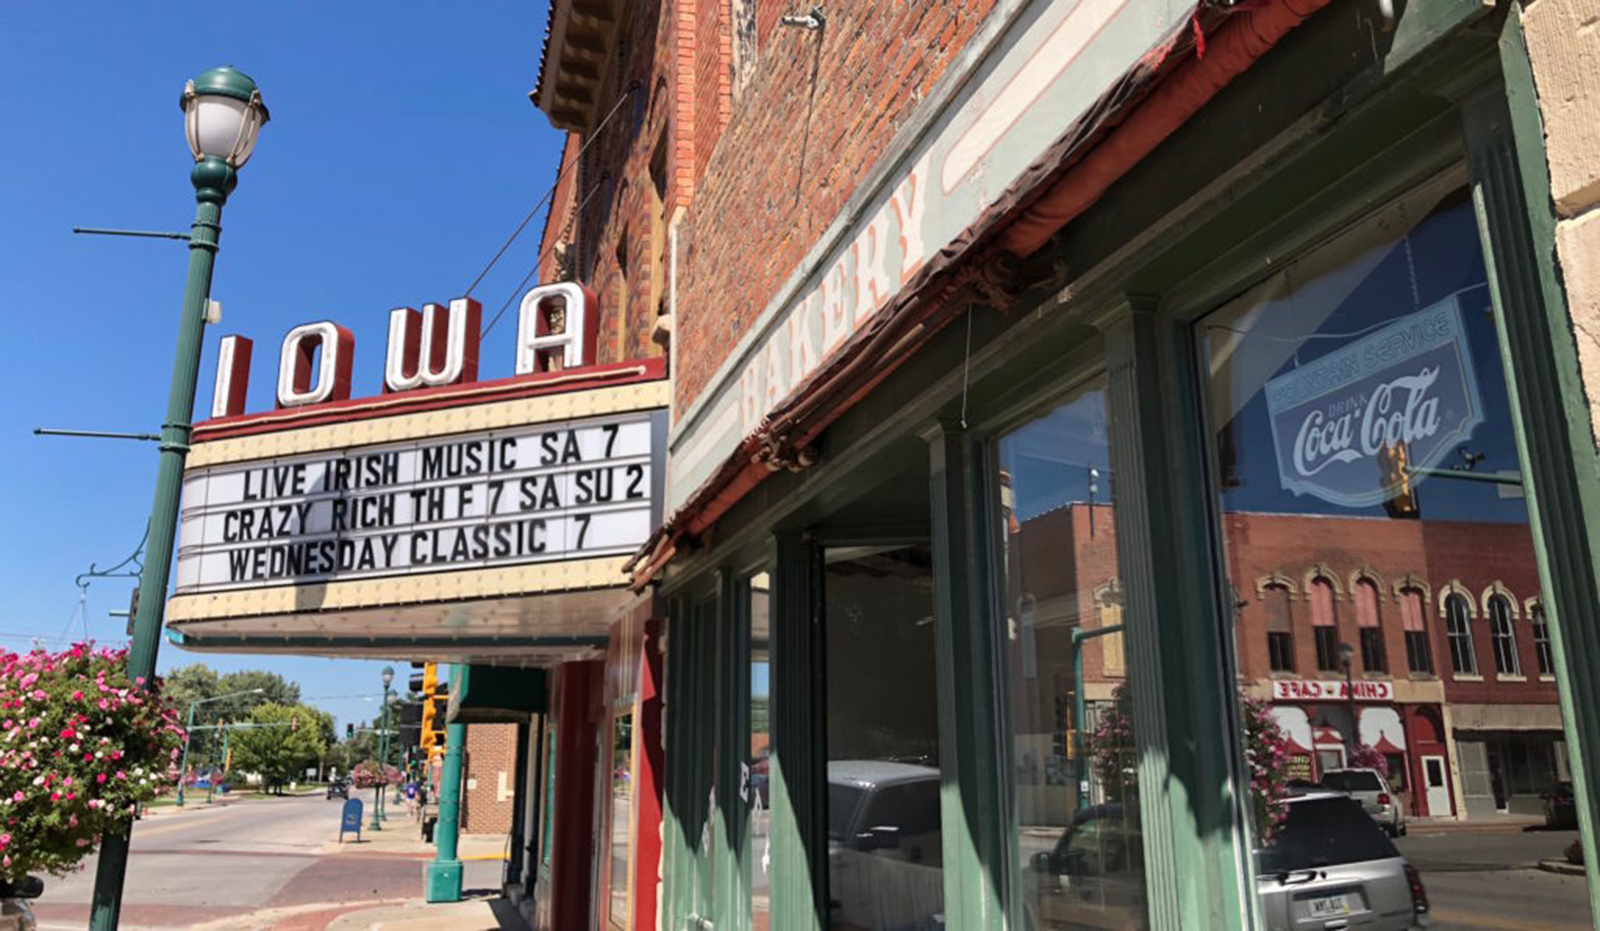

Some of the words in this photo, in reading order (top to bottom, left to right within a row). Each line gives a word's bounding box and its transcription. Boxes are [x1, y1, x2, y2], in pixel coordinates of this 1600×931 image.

[738, 146, 934, 436] BAKERY
[211, 281, 598, 419] IOWA
[1364, 310, 1451, 368] SERVICE
[243, 463, 306, 501] LIVE
[323, 452, 399, 491] IRISH
[421, 438, 517, 482] MUSIC
[541, 429, 582, 466] SA
[602, 423, 619, 459] 7
[223, 502, 314, 543] CRAZY
[332, 492, 396, 531] RICH
[410, 486, 444, 522] TH
[458, 485, 473, 518] F
[488, 480, 504, 516] 7
[519, 475, 560, 511] SA
[575, 467, 613, 504] SU
[626, 463, 643, 499] 2
[228, 534, 399, 582] WEDNESDAY
[410, 519, 546, 566] CLASSIC
[574, 513, 591, 551] 7
